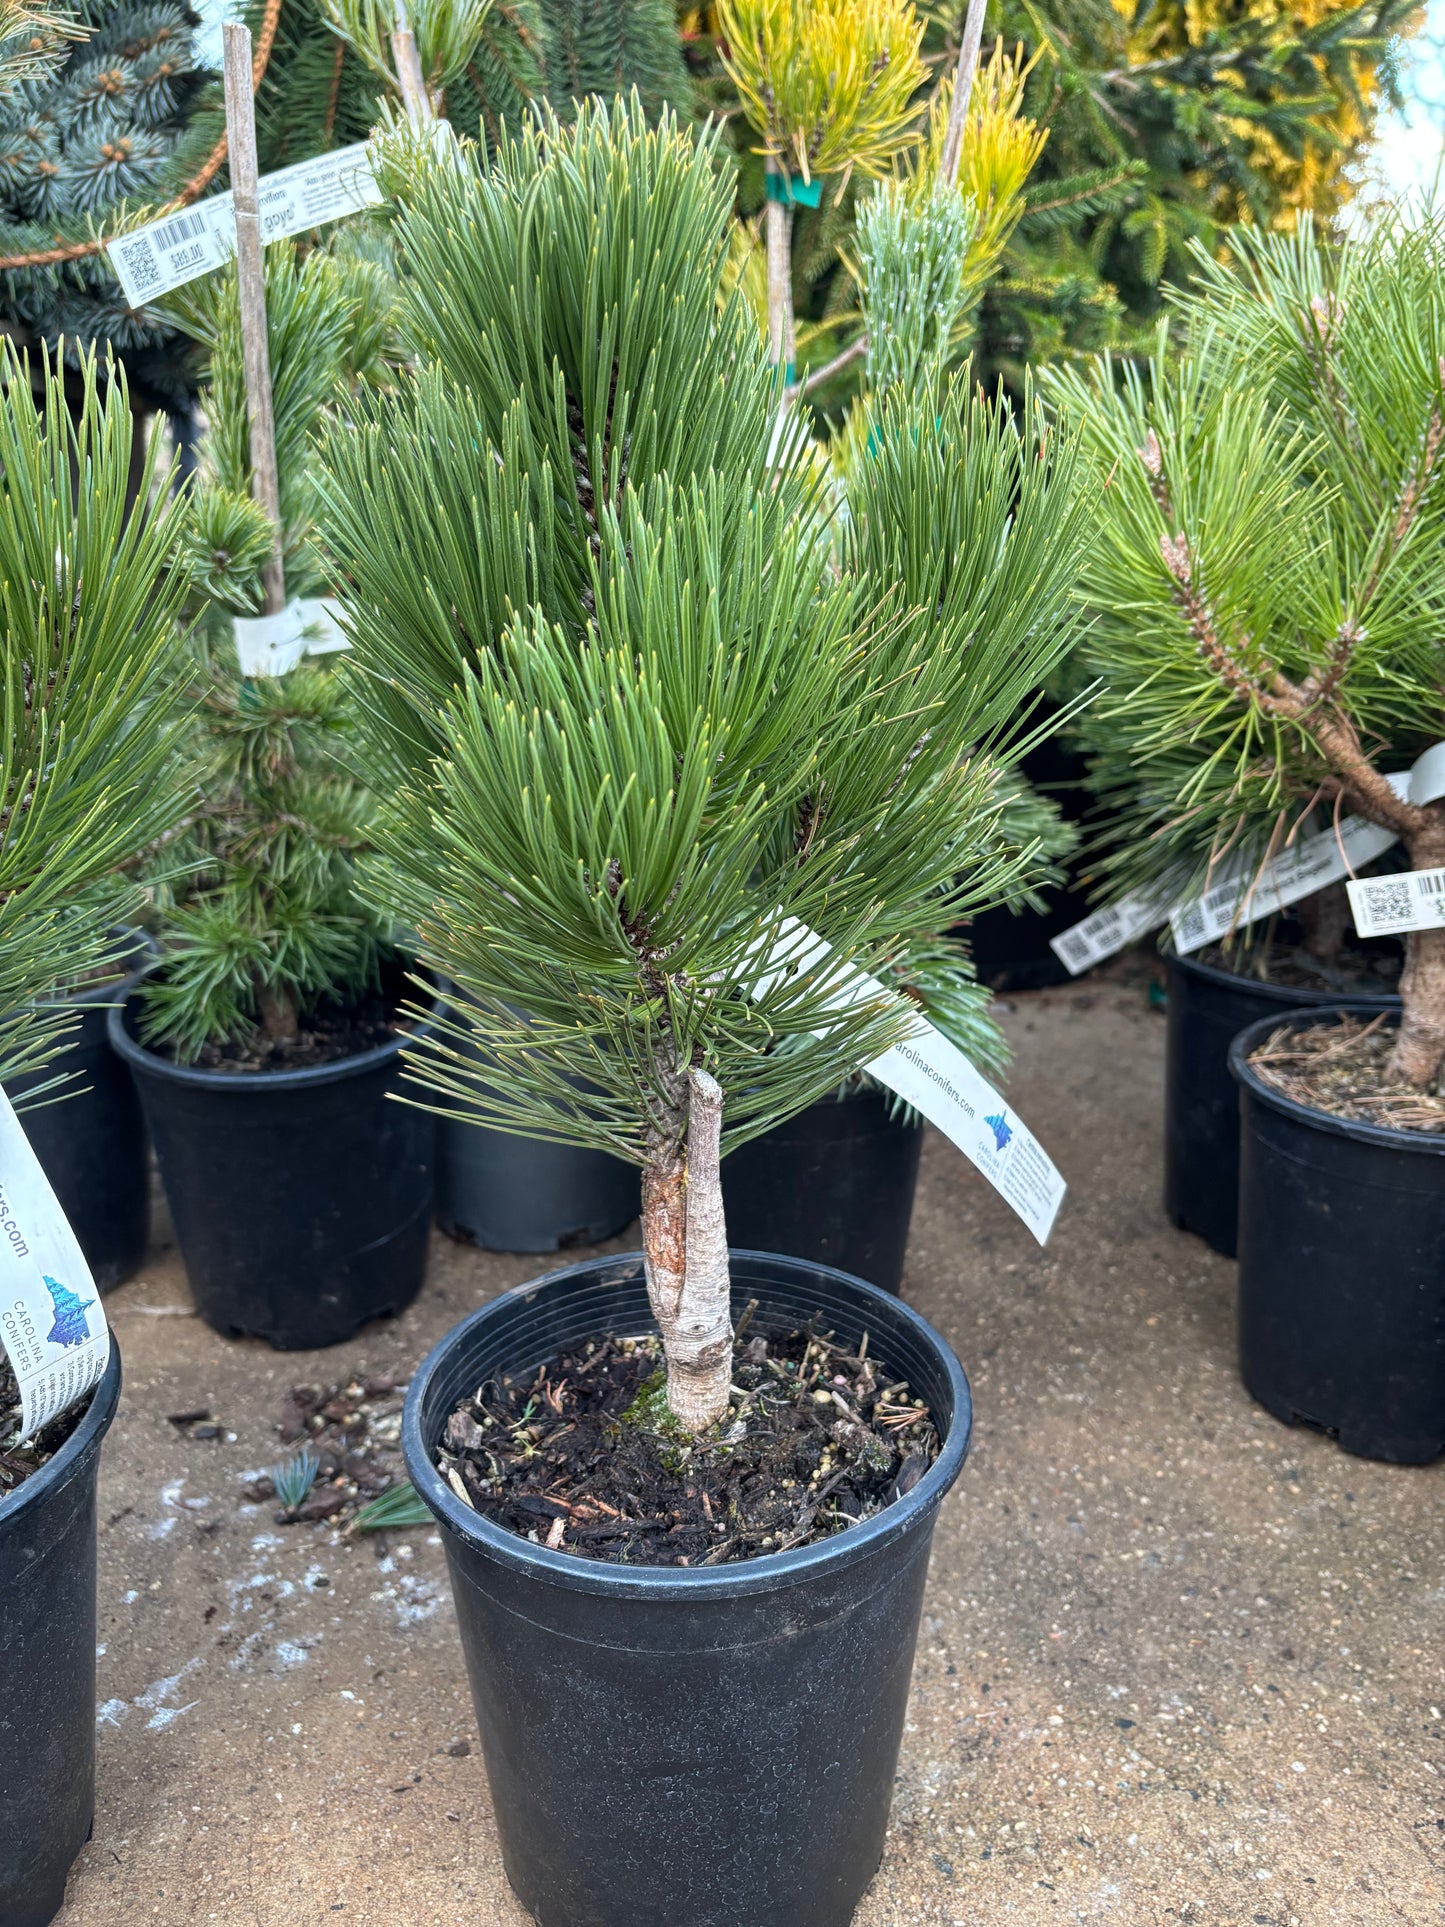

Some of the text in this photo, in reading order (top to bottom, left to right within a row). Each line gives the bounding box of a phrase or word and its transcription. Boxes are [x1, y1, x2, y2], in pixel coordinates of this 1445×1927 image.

[895, 1042, 976, 1118] arolinaconifers.com
[2, 1311, 32, 1371] CONIFERS
[14, 1300, 44, 1363] CAROLINA
